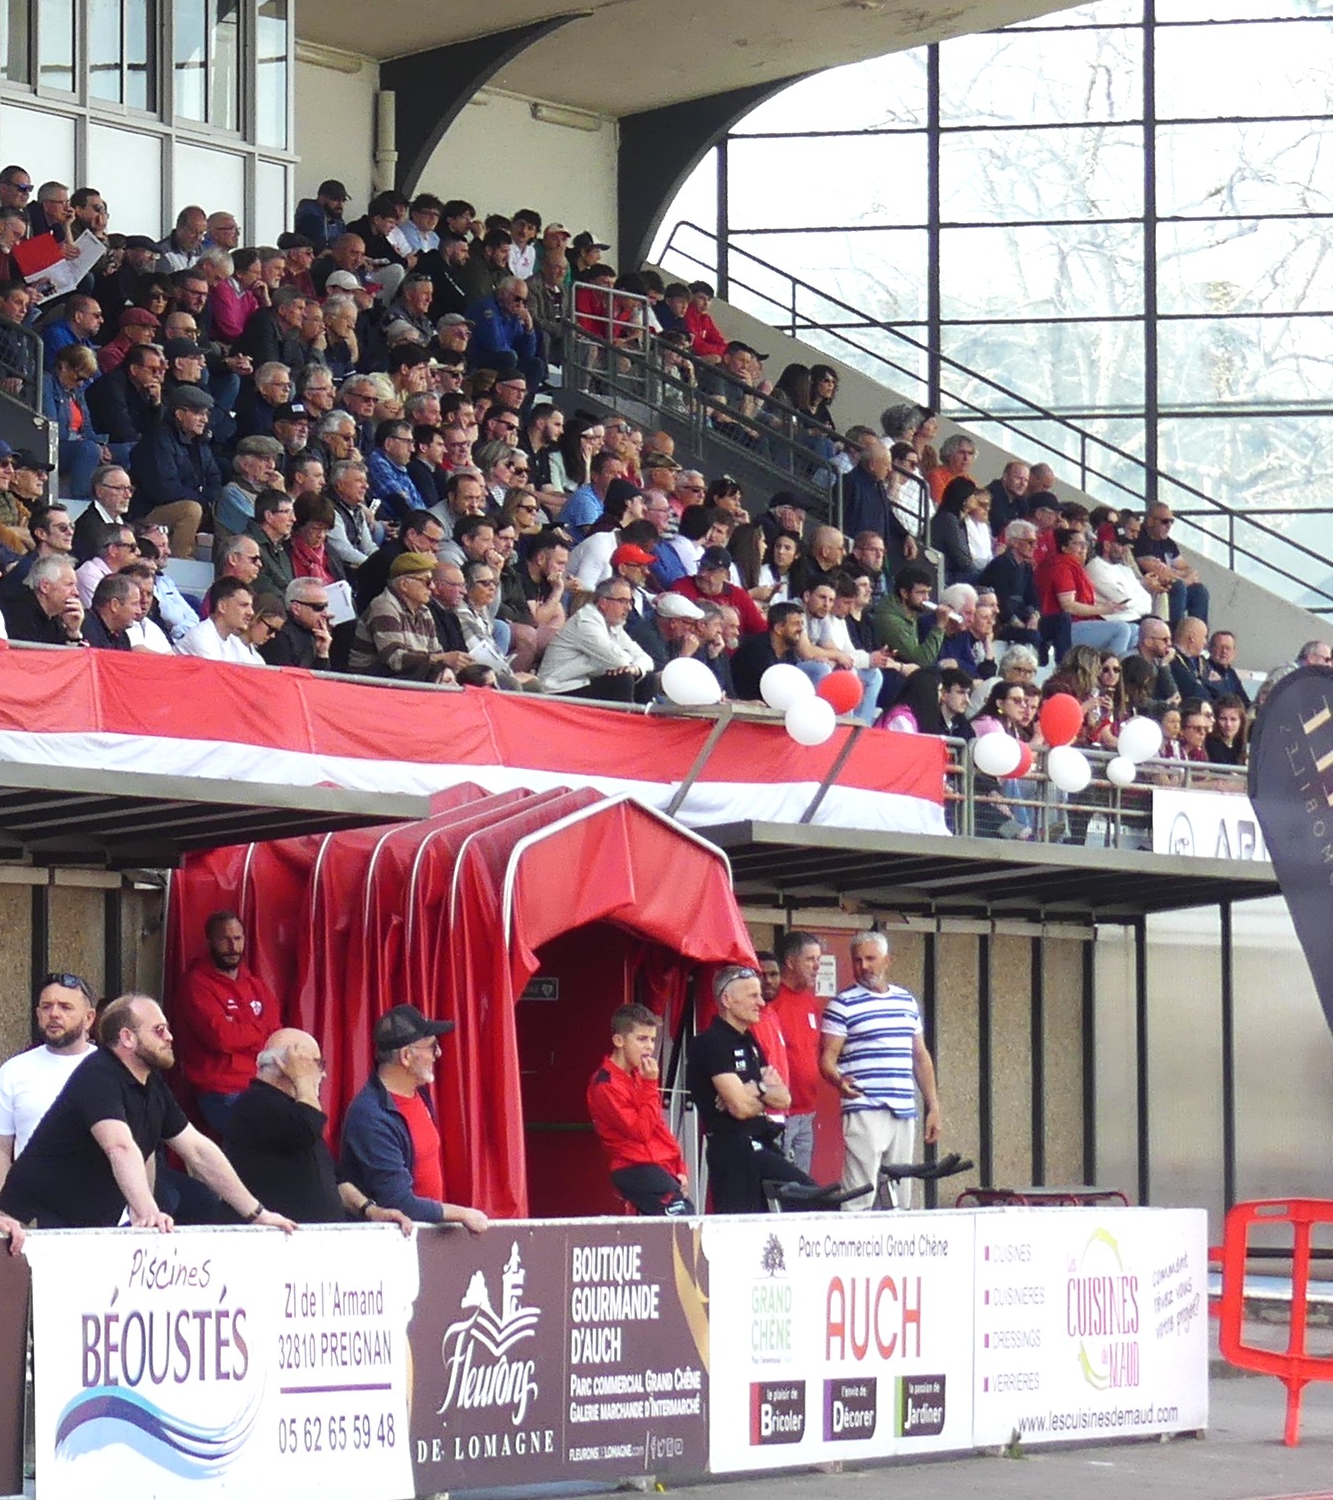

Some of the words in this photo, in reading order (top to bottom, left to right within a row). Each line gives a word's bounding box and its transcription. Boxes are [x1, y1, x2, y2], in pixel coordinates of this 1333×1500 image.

[799, 1234, 820, 1258] Parc
[823, 1234, 884, 1258] Commercial
[886, 1234, 915, 1258] Grand
[917, 1232, 949, 1258] Chêne
[993, 1244, 1032, 1263] CUISINES
[128, 1247, 212, 1291] Piscines
[572, 1245, 642, 1285] BOUTIQUE
[301, 1282, 317, 1318] de
[571, 1285, 660, 1323] GOURMANDE
[751, 1285, 792, 1315] GRAND
[1067, 1275, 1139, 1337] CUISINES
[81, 1284, 249, 1388] BÉOUSTÉS
[751, 1314, 792, 1352] CHÊNE
[825, 1275, 921, 1362] AUCH
[278, 1333, 316, 1370] 32810
[320, 1329, 393, 1368] PREIGNAN
[571, 1327, 622, 1365] D'AUCH
[993, 1329, 1041, 1349] DRESSINGS
[570, 1374, 592, 1399] PARC
[593, 1373, 644, 1396] COMMERCIAL
[645, 1369, 674, 1394] GRAND
[674, 1366, 702, 1391] CHÊNE
[1109, 1341, 1139, 1389] MAUD
[570, 1402, 600, 1424] GALERIE
[600, 1400, 644, 1420] MARCHANDE
[760, 1403, 803, 1437] Bricoler
[832, 1400, 874, 1433] Décorer
[904, 1398, 943, 1430] Jardiner
[1018, 1404, 1179, 1432] www.lescuisinesdemaud.com
[278, 1417, 298, 1455] 05
[303, 1416, 323, 1453] 62
[328, 1415, 347, 1451] 65
[353, 1414, 371, 1449] 59
[377, 1412, 396, 1449] 48
[417, 1439, 442, 1463] DE
[454, 1430, 554, 1460] LOMAGNE
